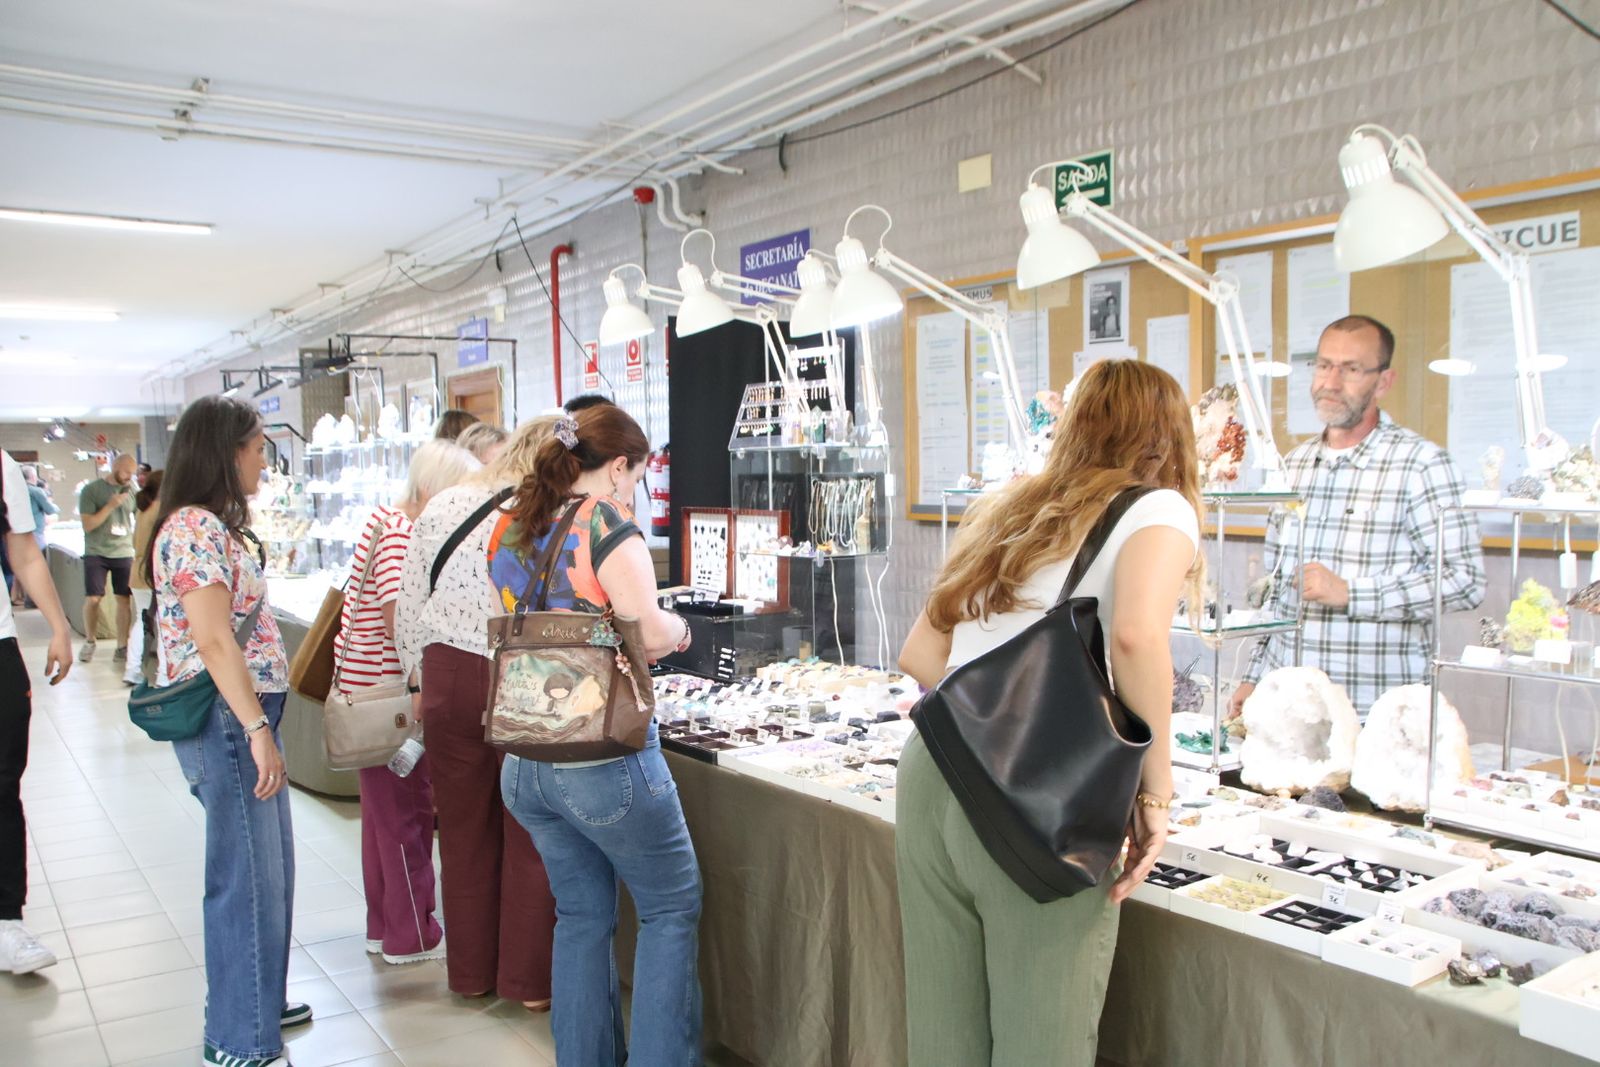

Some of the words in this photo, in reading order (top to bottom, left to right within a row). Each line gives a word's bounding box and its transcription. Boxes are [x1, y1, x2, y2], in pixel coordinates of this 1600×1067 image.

[1494, 219, 1578, 250] ICUE
[744, 235, 805, 272] SECRETARÍA
[1256, 872, 1268, 882] 4€
